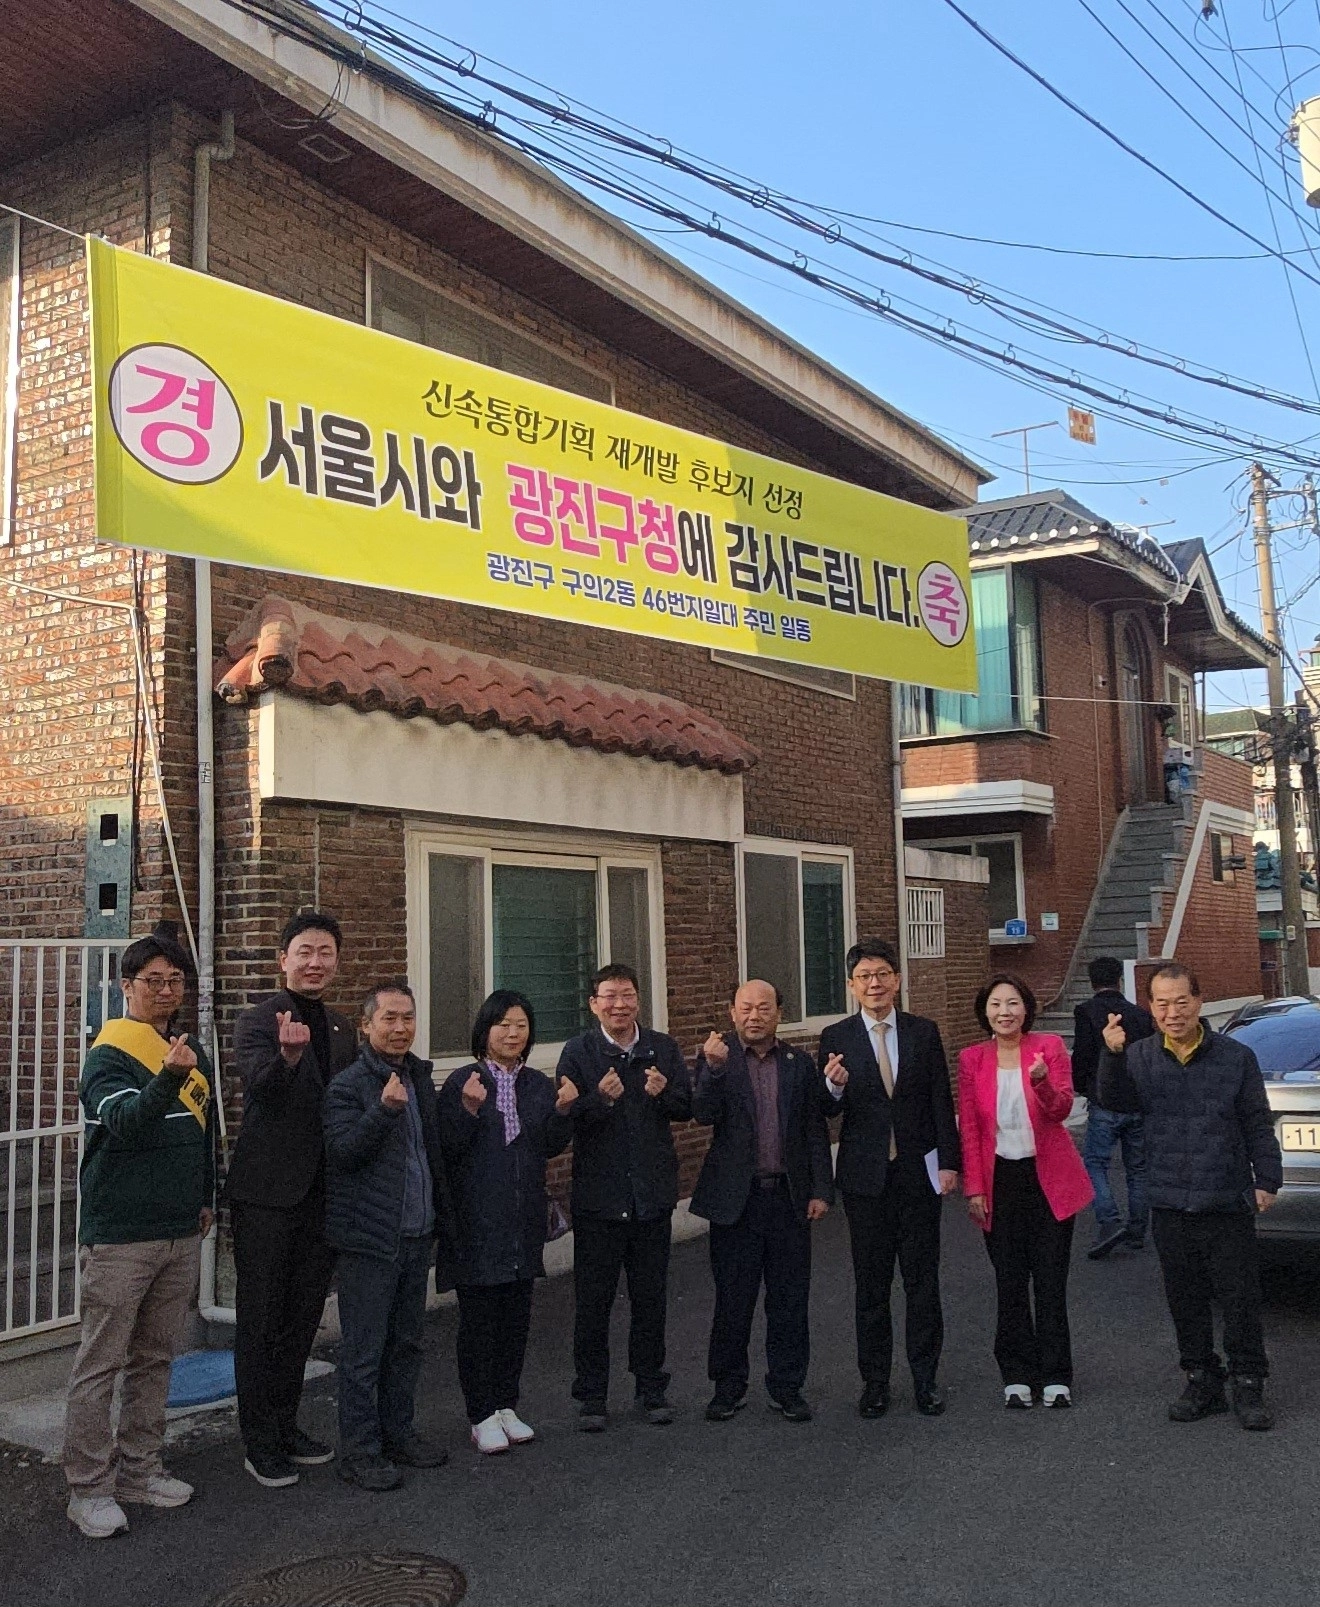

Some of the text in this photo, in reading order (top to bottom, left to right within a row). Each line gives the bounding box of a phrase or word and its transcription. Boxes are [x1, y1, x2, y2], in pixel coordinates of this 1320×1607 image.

[125, 363, 217, 467] 경
[421, 379, 803, 520] 신속통합기획 재개발 후보지 선정
[260, 400, 921, 628] 서울시와 광진구청에 감사드립니다.
[487, 552, 812, 643] 광진구 구의2동 46번지일대 주민 일동
[923, 573, 964, 637] 축
[1295, 1127, 1316, 1146] 11
